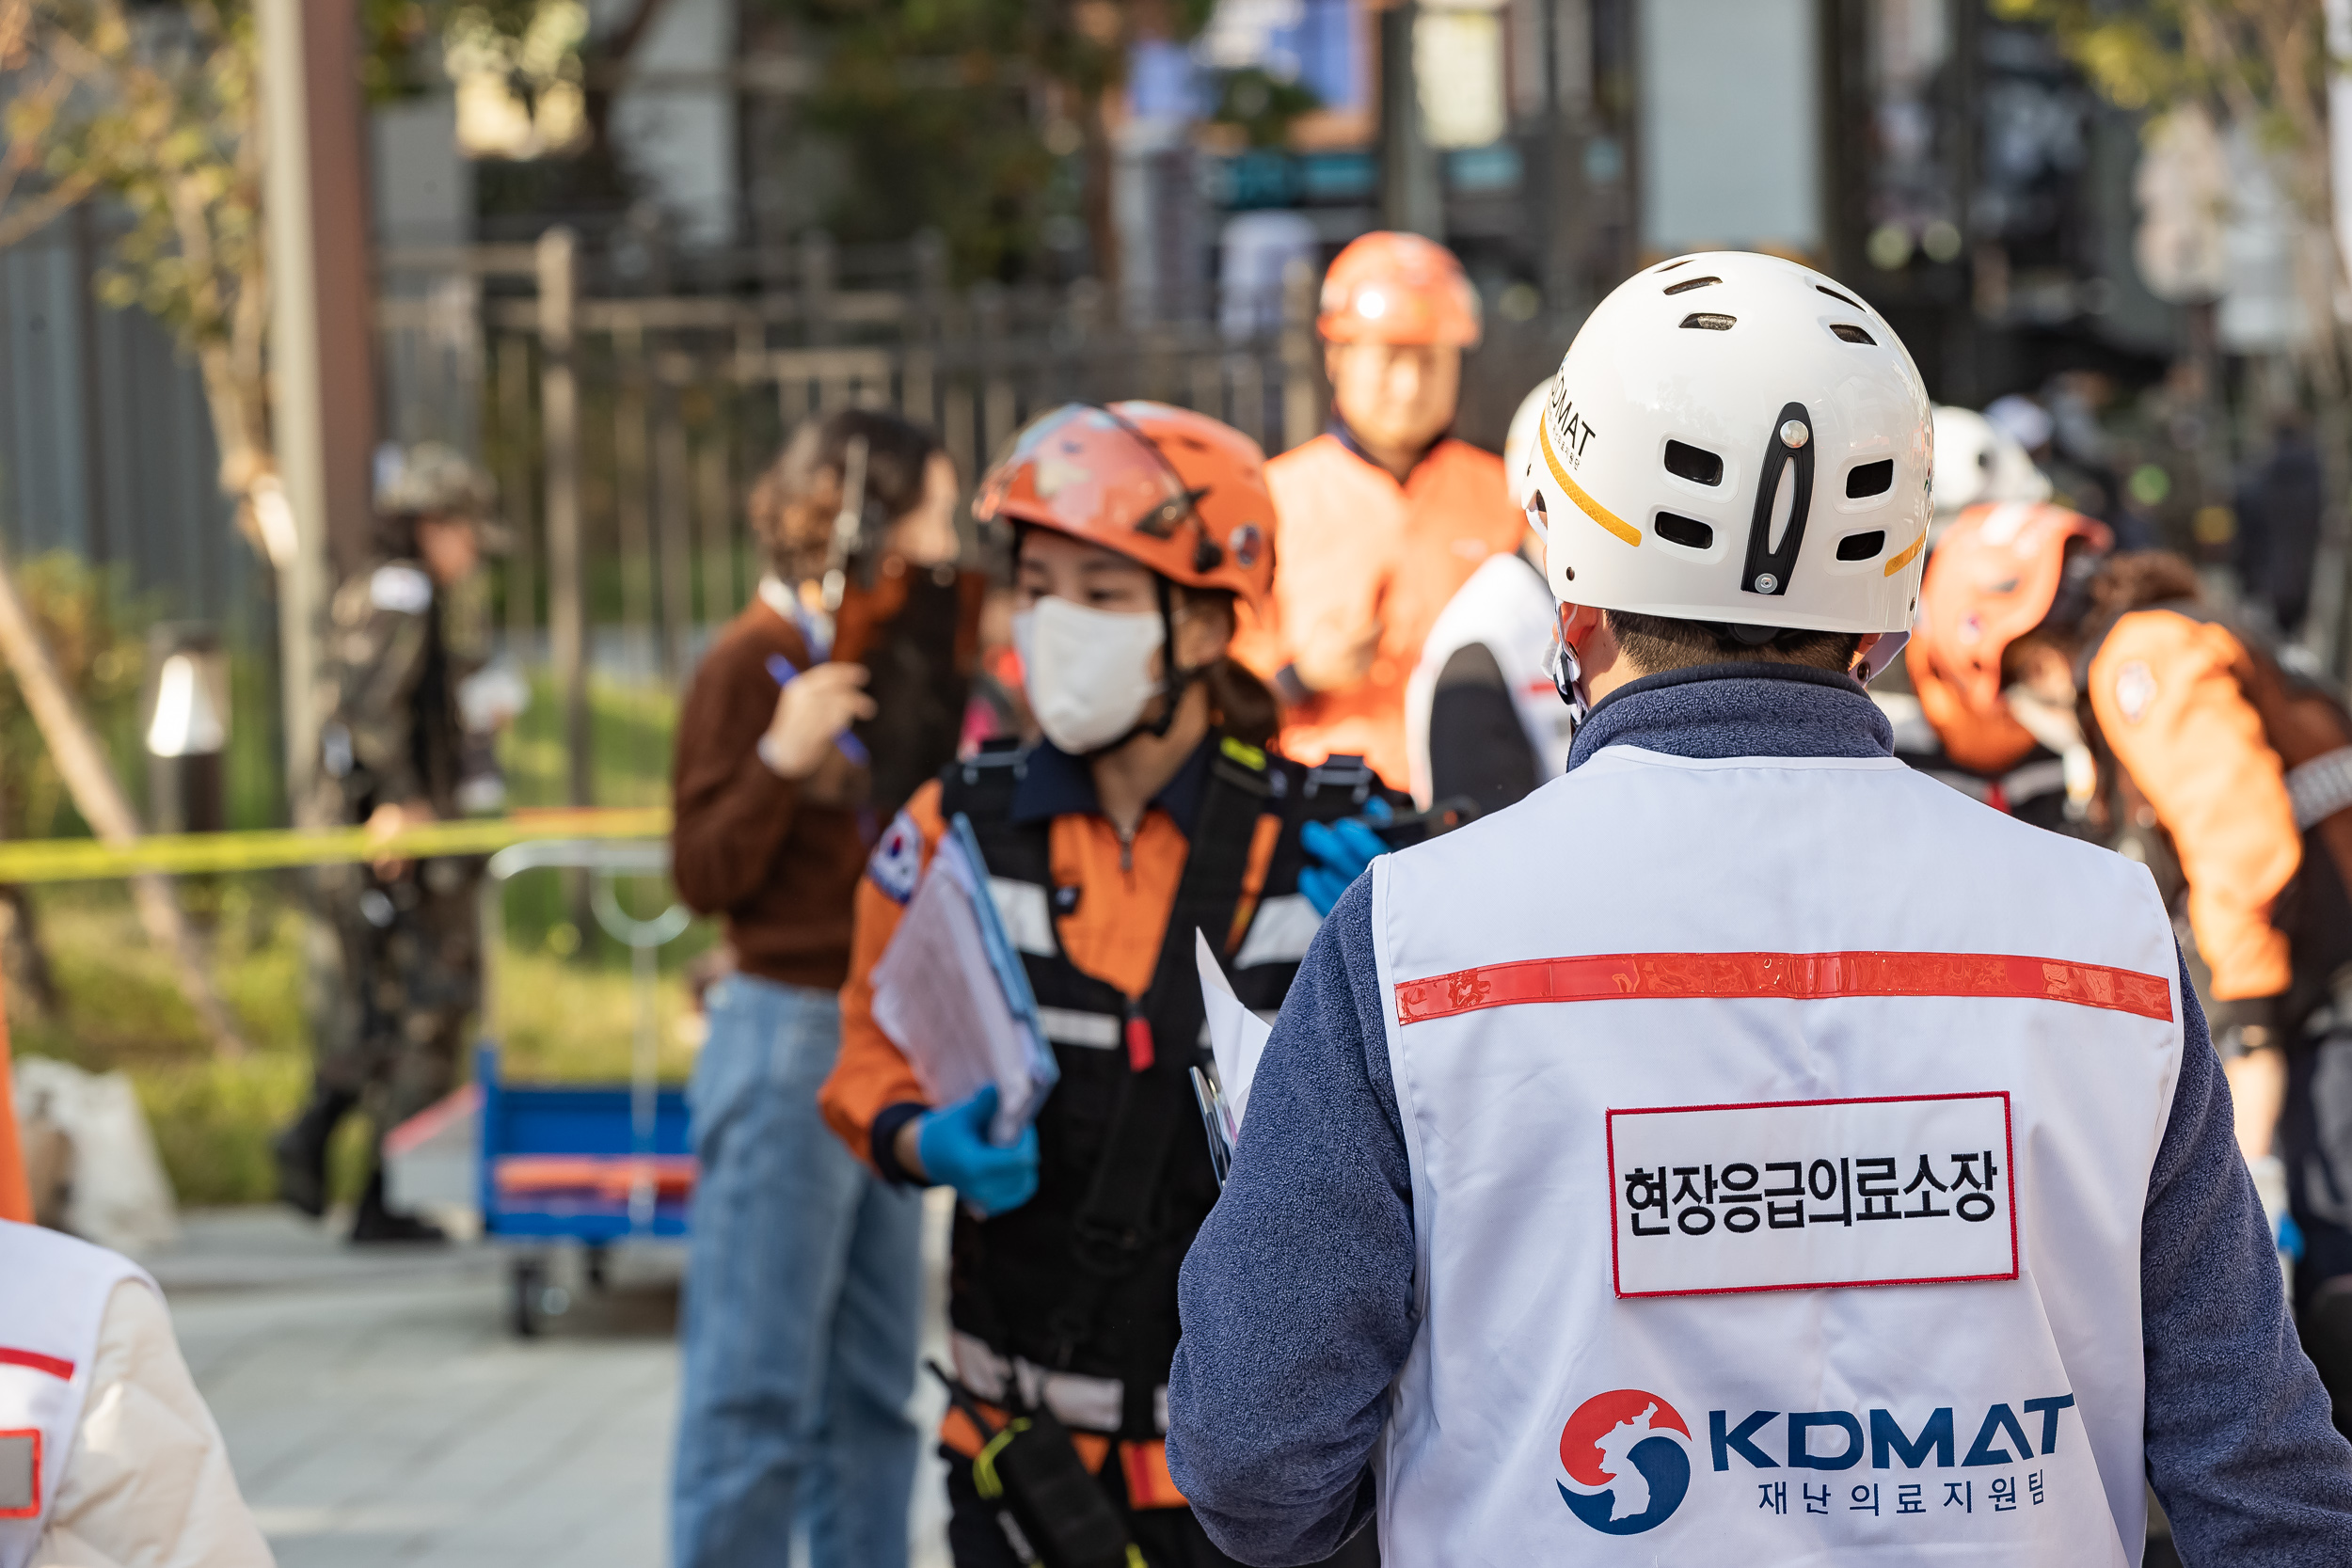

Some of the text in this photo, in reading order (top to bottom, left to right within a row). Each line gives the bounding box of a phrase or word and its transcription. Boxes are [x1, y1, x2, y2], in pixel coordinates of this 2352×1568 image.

[1624, 1149, 1998, 1237] 현장응급의료소장
[1708, 1392, 2076, 1472] KDMAT
[1757, 1467, 2045, 1517] 재난의료지원팀
